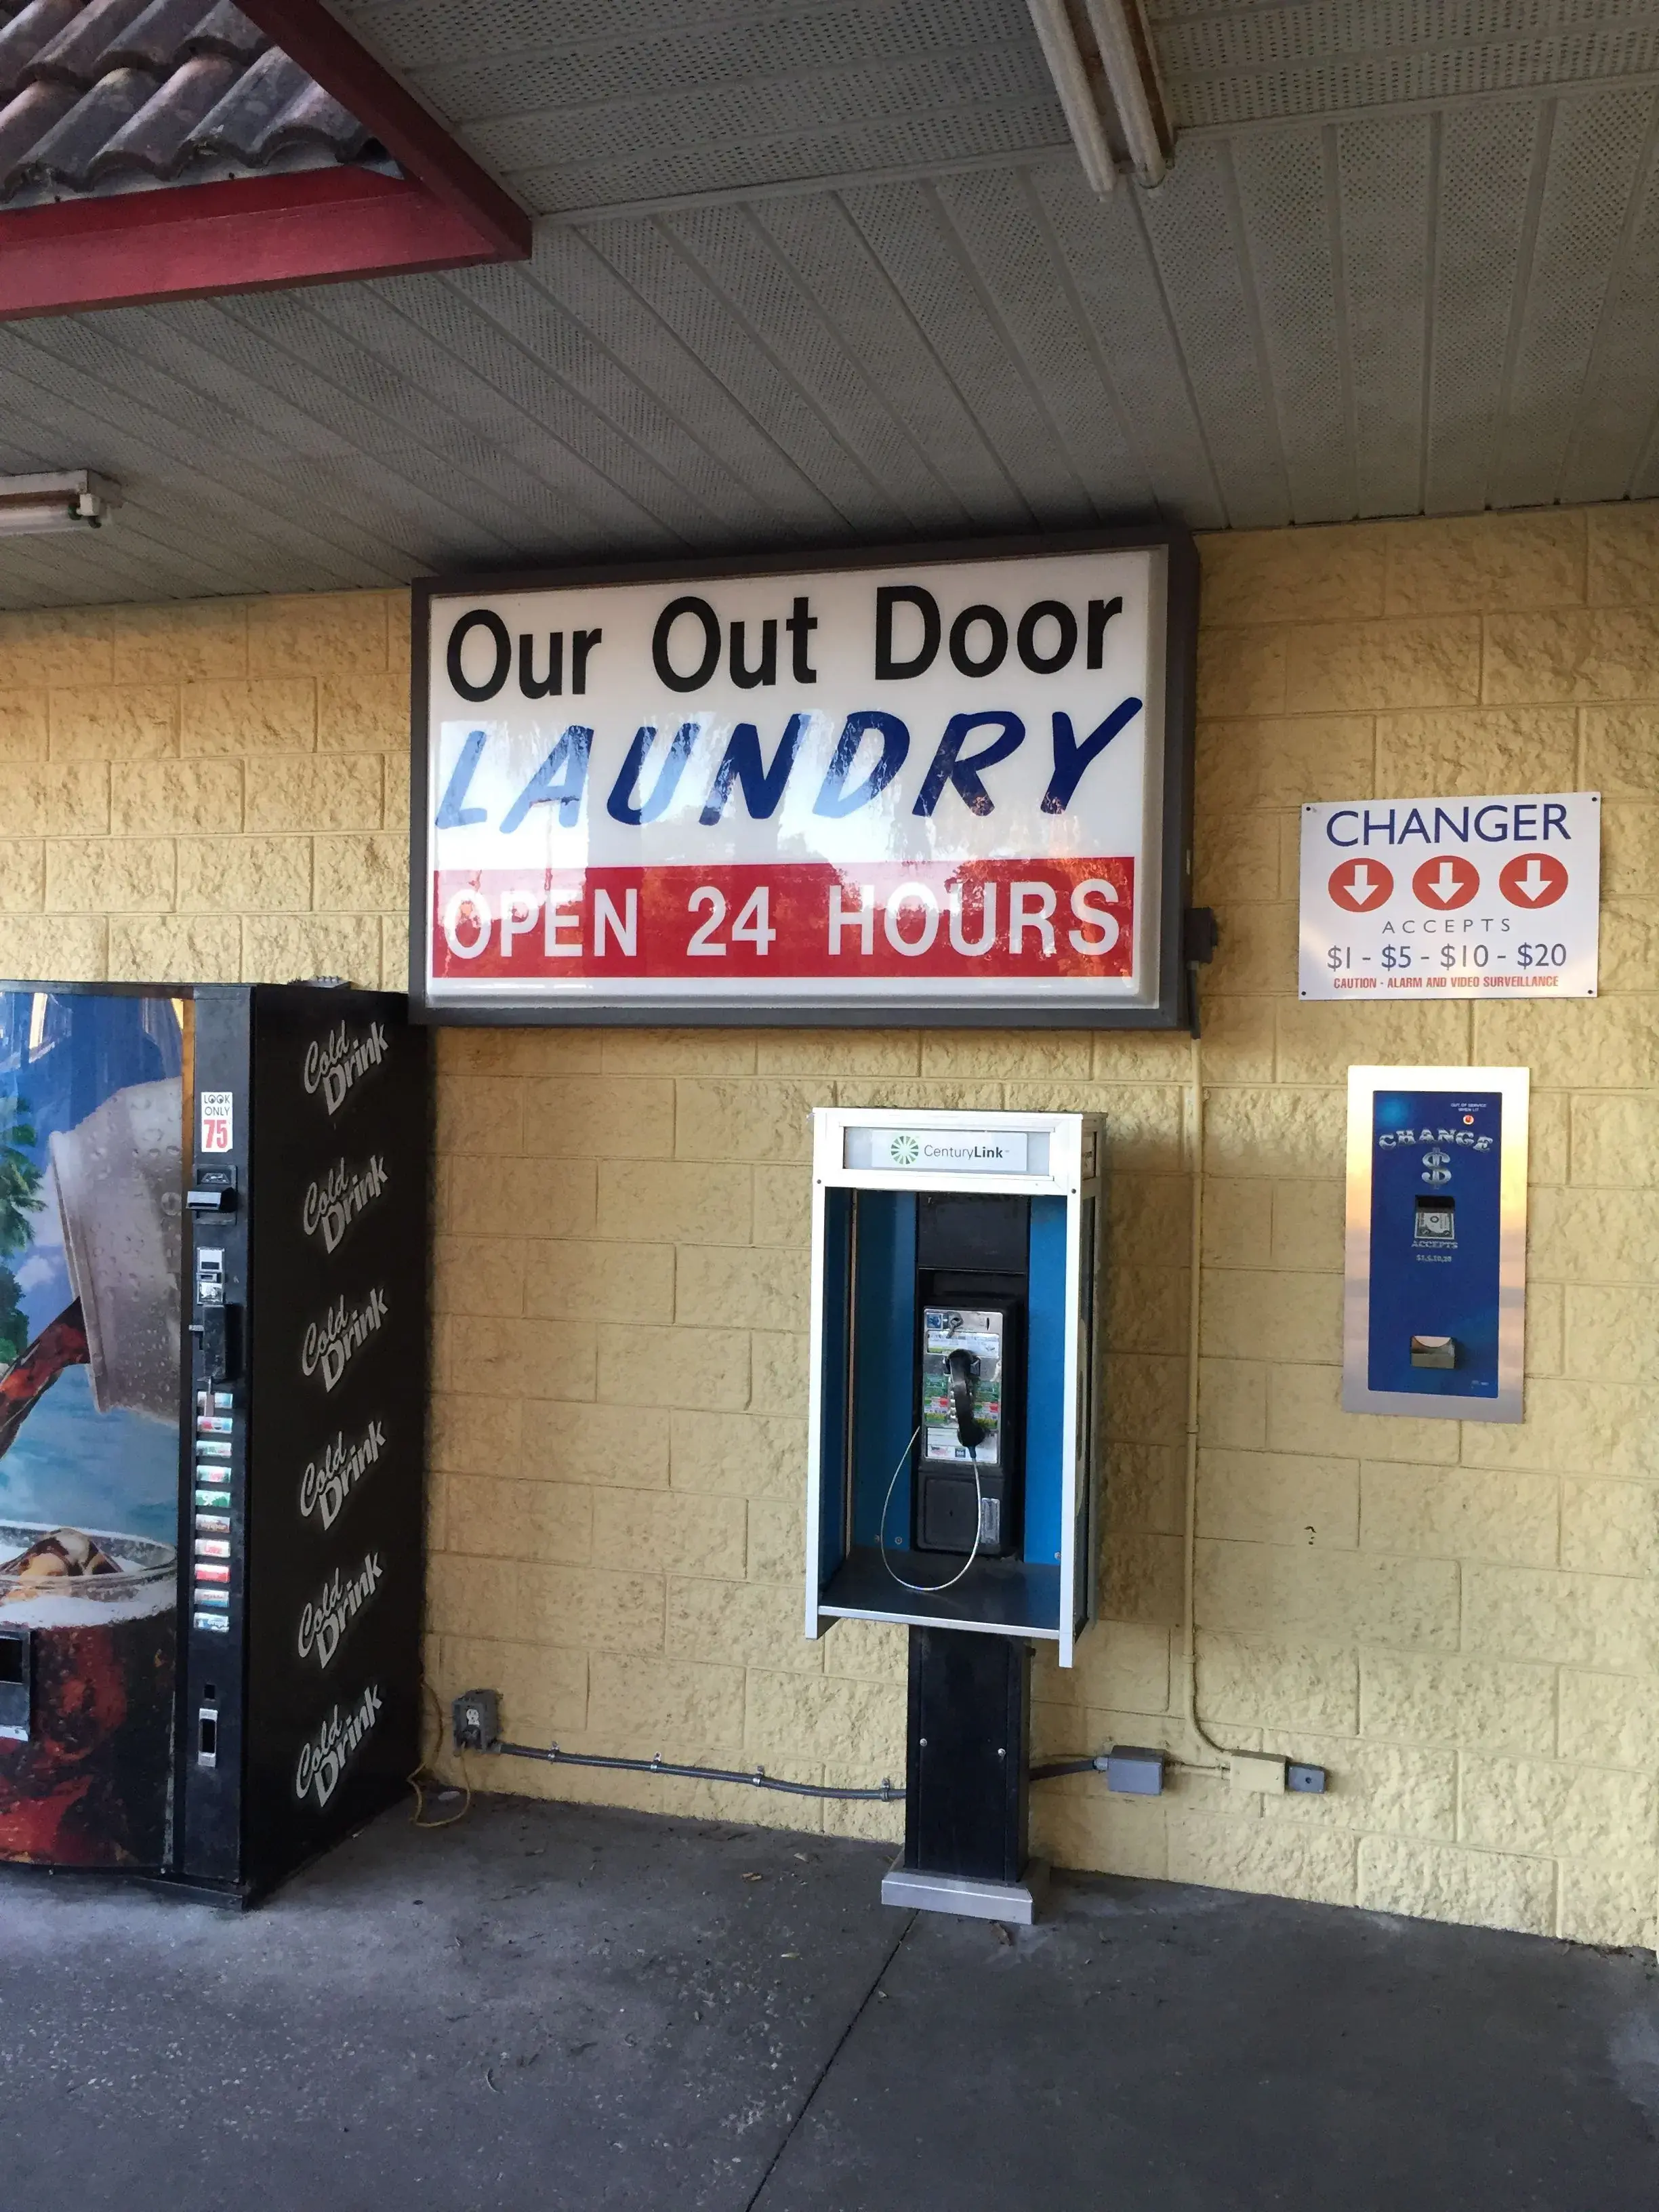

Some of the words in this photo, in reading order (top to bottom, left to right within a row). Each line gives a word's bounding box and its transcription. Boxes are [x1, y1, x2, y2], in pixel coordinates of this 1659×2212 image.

[445, 607, 602, 703] Our
[651, 596, 818, 693] Out
[875, 585, 1123, 681] Door
[435, 697, 1143, 834] LAUNDRY
[1326, 804, 1572, 847] CHANGER
[445, 887, 638, 960] OPEN
[686, 886, 777, 956] 24
[827, 880, 1121, 958] HOURS
[1327, 945, 1351, 972] $1
[1381, 944, 1412, 971] $5
[1440, 943, 1489, 970] $10
[1517, 942, 1567, 970] $20
[1382, 918, 1511, 935] ACCEPTS
[1334, 977, 1377, 989] CAUTION
[1387, 977, 1423, 988] ALARM
[1426, 977, 1447, 987] AND
[1450, 976, 1479, 987] VIDEO
[1483, 975, 1559, 987] SURVEILLANCE
[304, 1019, 350, 1094] Cold
[323, 1021, 389, 1116] Drink
[204, 1094, 230, 1103] LOOK
[204, 1120, 228, 1149] 75
[205, 1106, 230, 1116] ONLY
[924, 1144, 1004, 1160] CenturyLink
[1378, 1128, 1493, 1152] CHANGE
[303, 1157, 349, 1235] Cold
[322, 1155, 389, 1254] Drink
[1411, 1240, 1458, 1249] ACCEPTS
[302, 1294, 348, 1376] Cold
[321, 1288, 389, 1393] Drink
[300, 1431, 346, 1517] Cold
[319, 1420, 386, 1531] Drink
[298, 1567, 344, 1658] Cold
[316, 1553, 383, 1669] Drink
[296, 1704, 342, 1799] Cold
[314, 1684, 383, 1807] Drink
